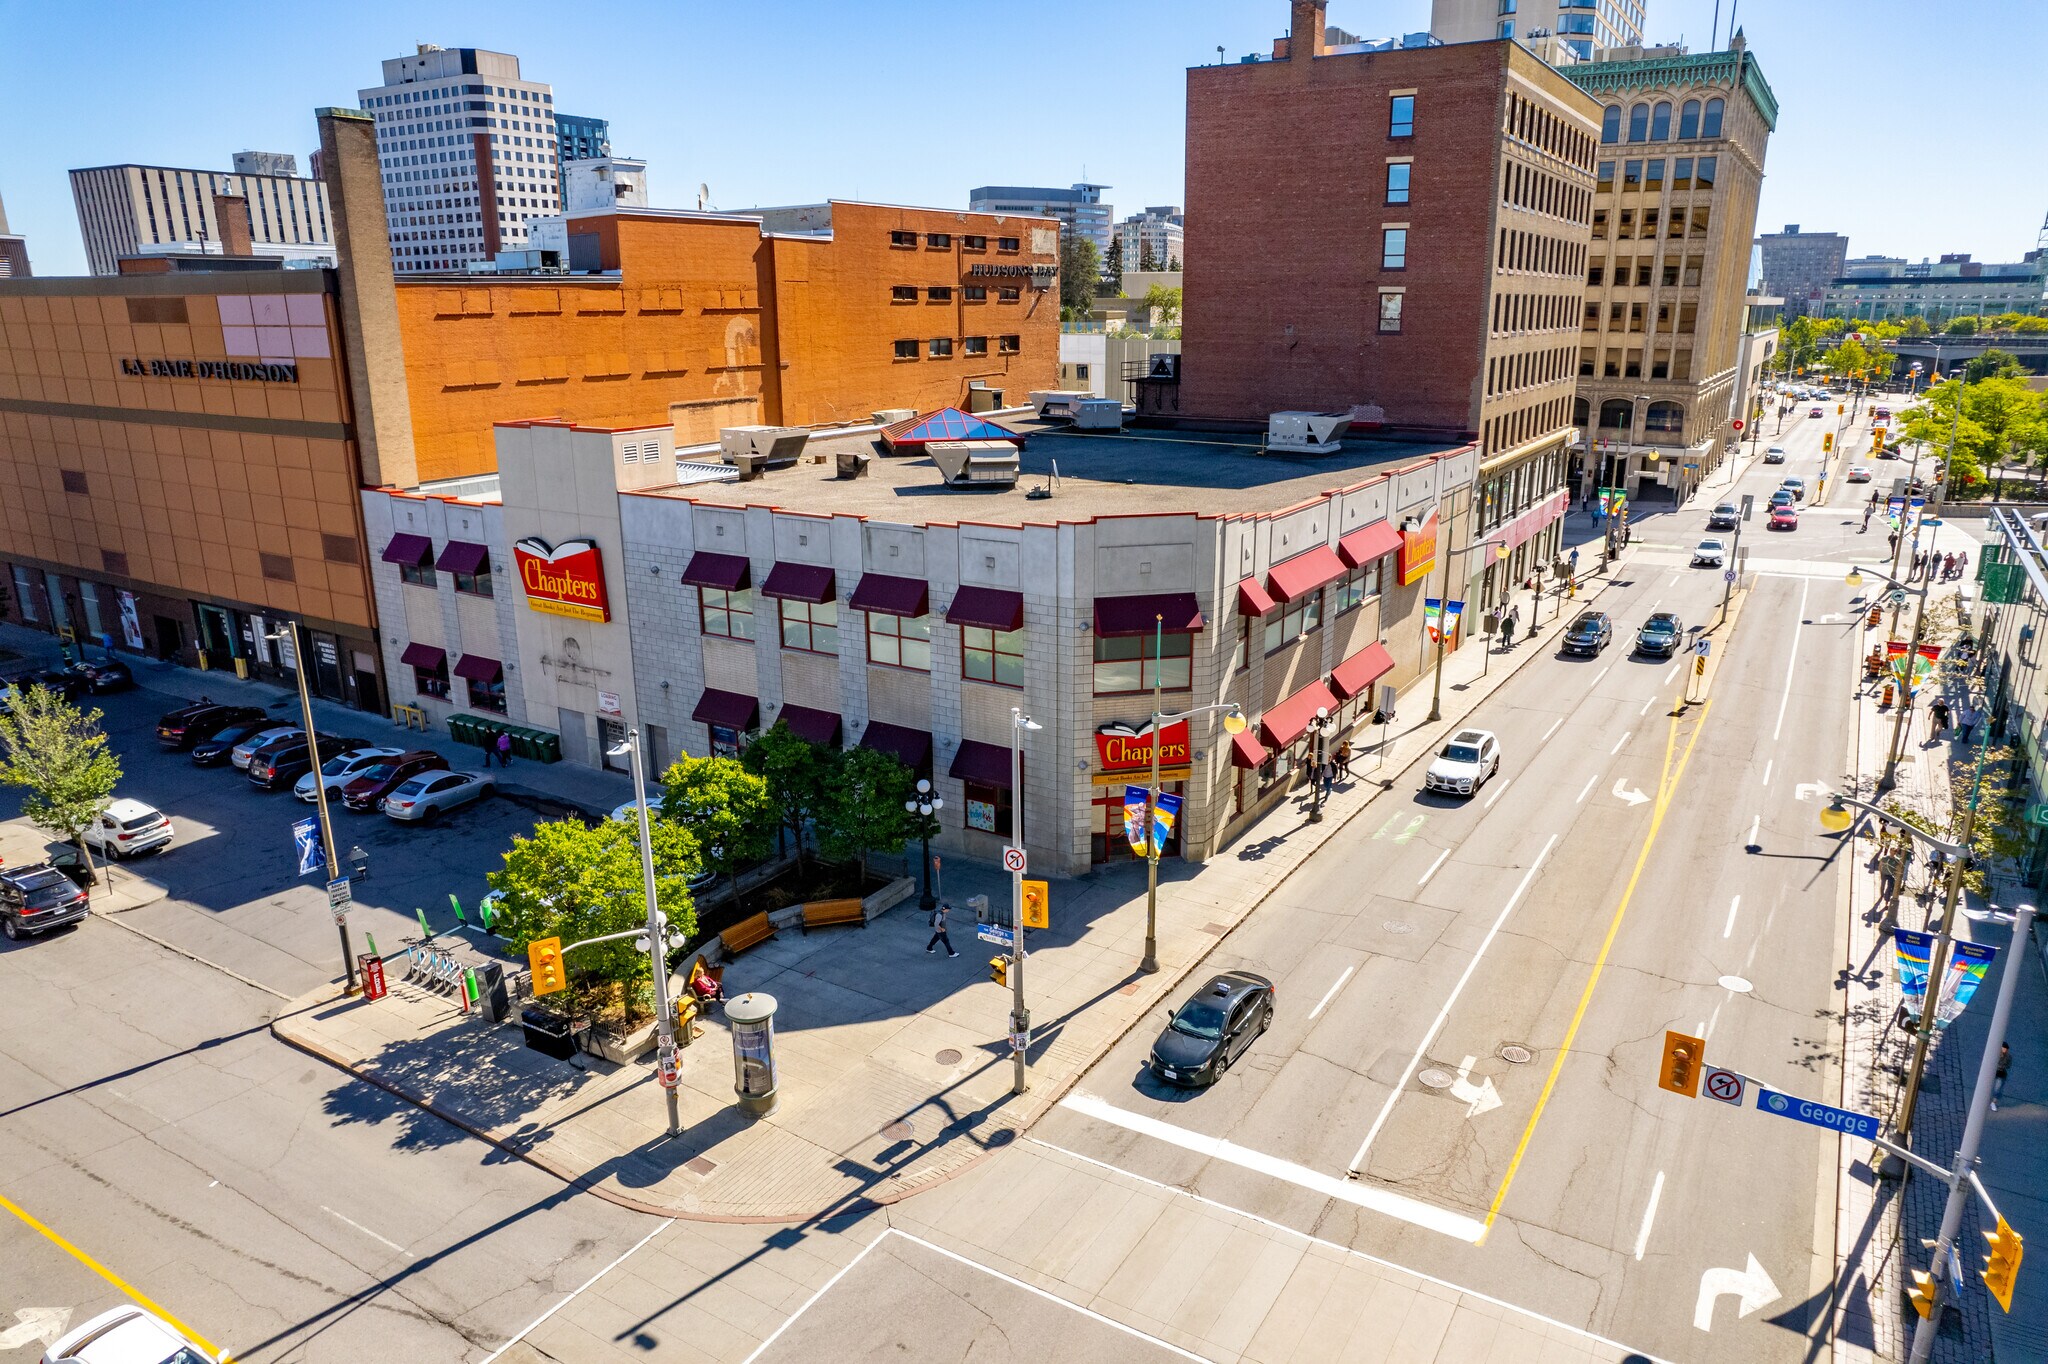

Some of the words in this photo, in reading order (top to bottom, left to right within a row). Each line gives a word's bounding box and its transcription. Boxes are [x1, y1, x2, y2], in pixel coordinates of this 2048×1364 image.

[972, 264, 1034, 277] HUDSON'S
[1037, 265, 1058, 277] BAY
[120, 358, 145, 377] LA
[150, 359, 195, 378] BAIE
[197, 360, 298, 384] D'HUDSON
[1406, 533, 1435, 566] Chapters
[524, 558, 597, 600] Chapters
[601, 692, 617, 701] LOADING
[1106, 737, 1185, 765] Chapers
[1799, 1102, 1868, 1133] George
